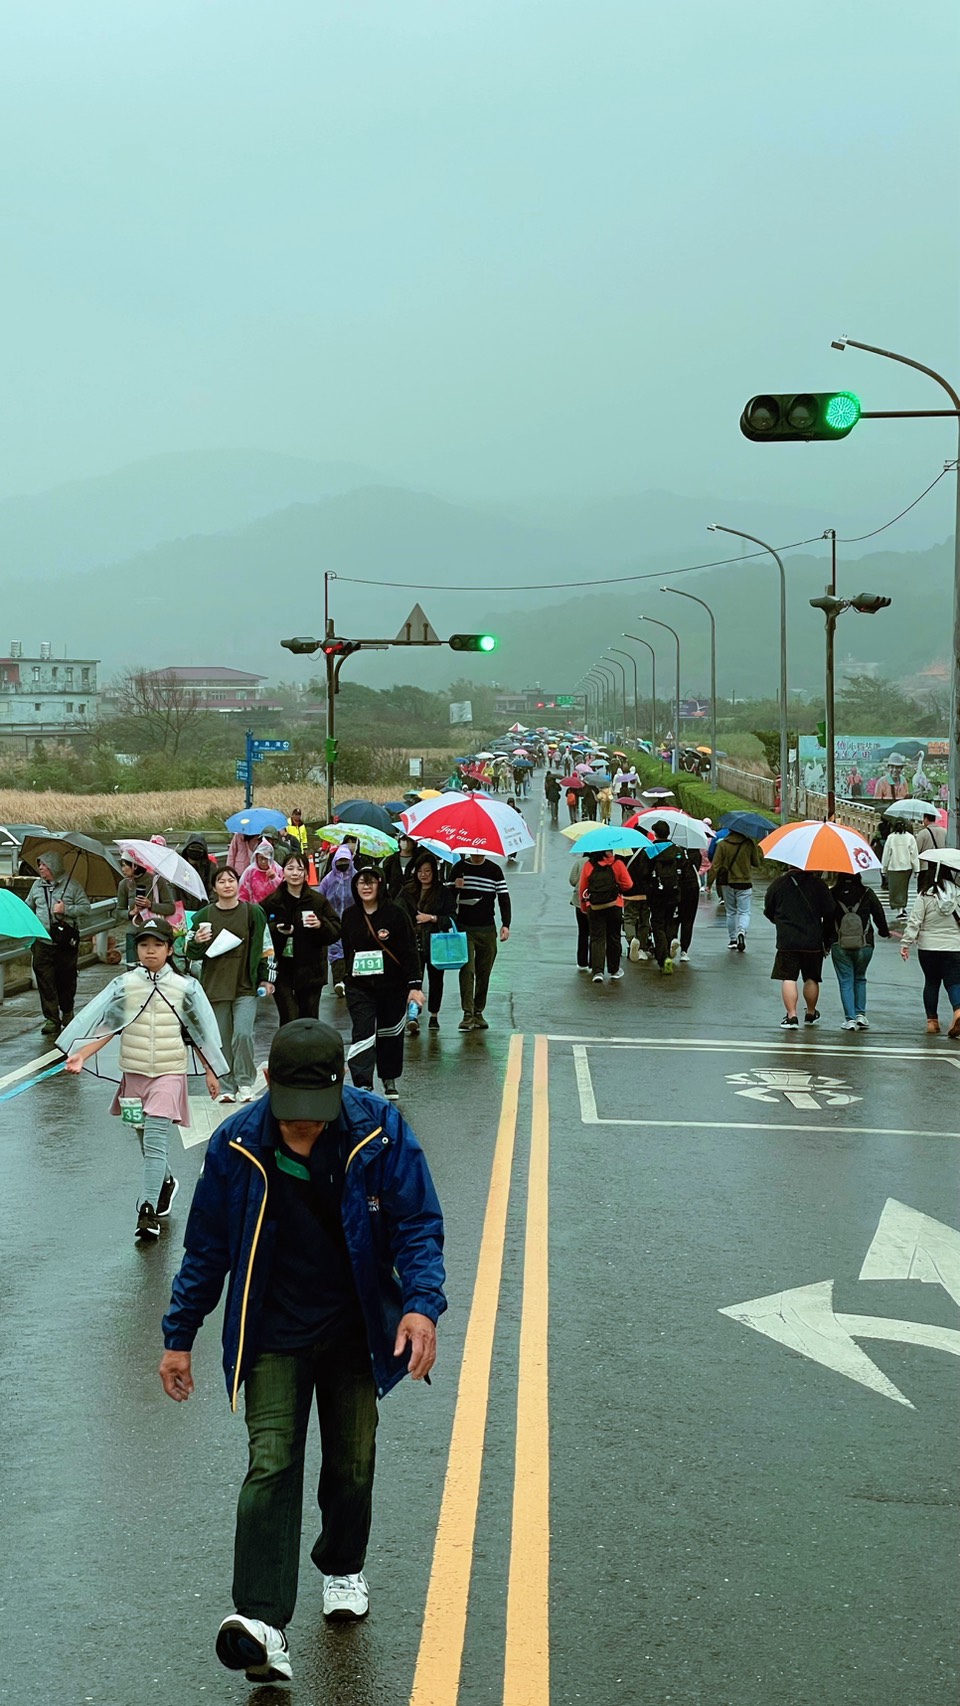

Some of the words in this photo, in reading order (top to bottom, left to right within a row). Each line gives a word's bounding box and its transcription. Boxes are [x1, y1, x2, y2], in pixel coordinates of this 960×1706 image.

[437, 825, 455, 834] Joy
[472, 837, 487, 846] life
[354, 959, 381, 969] 0191
[123, 1108, 142, 1120] 35
